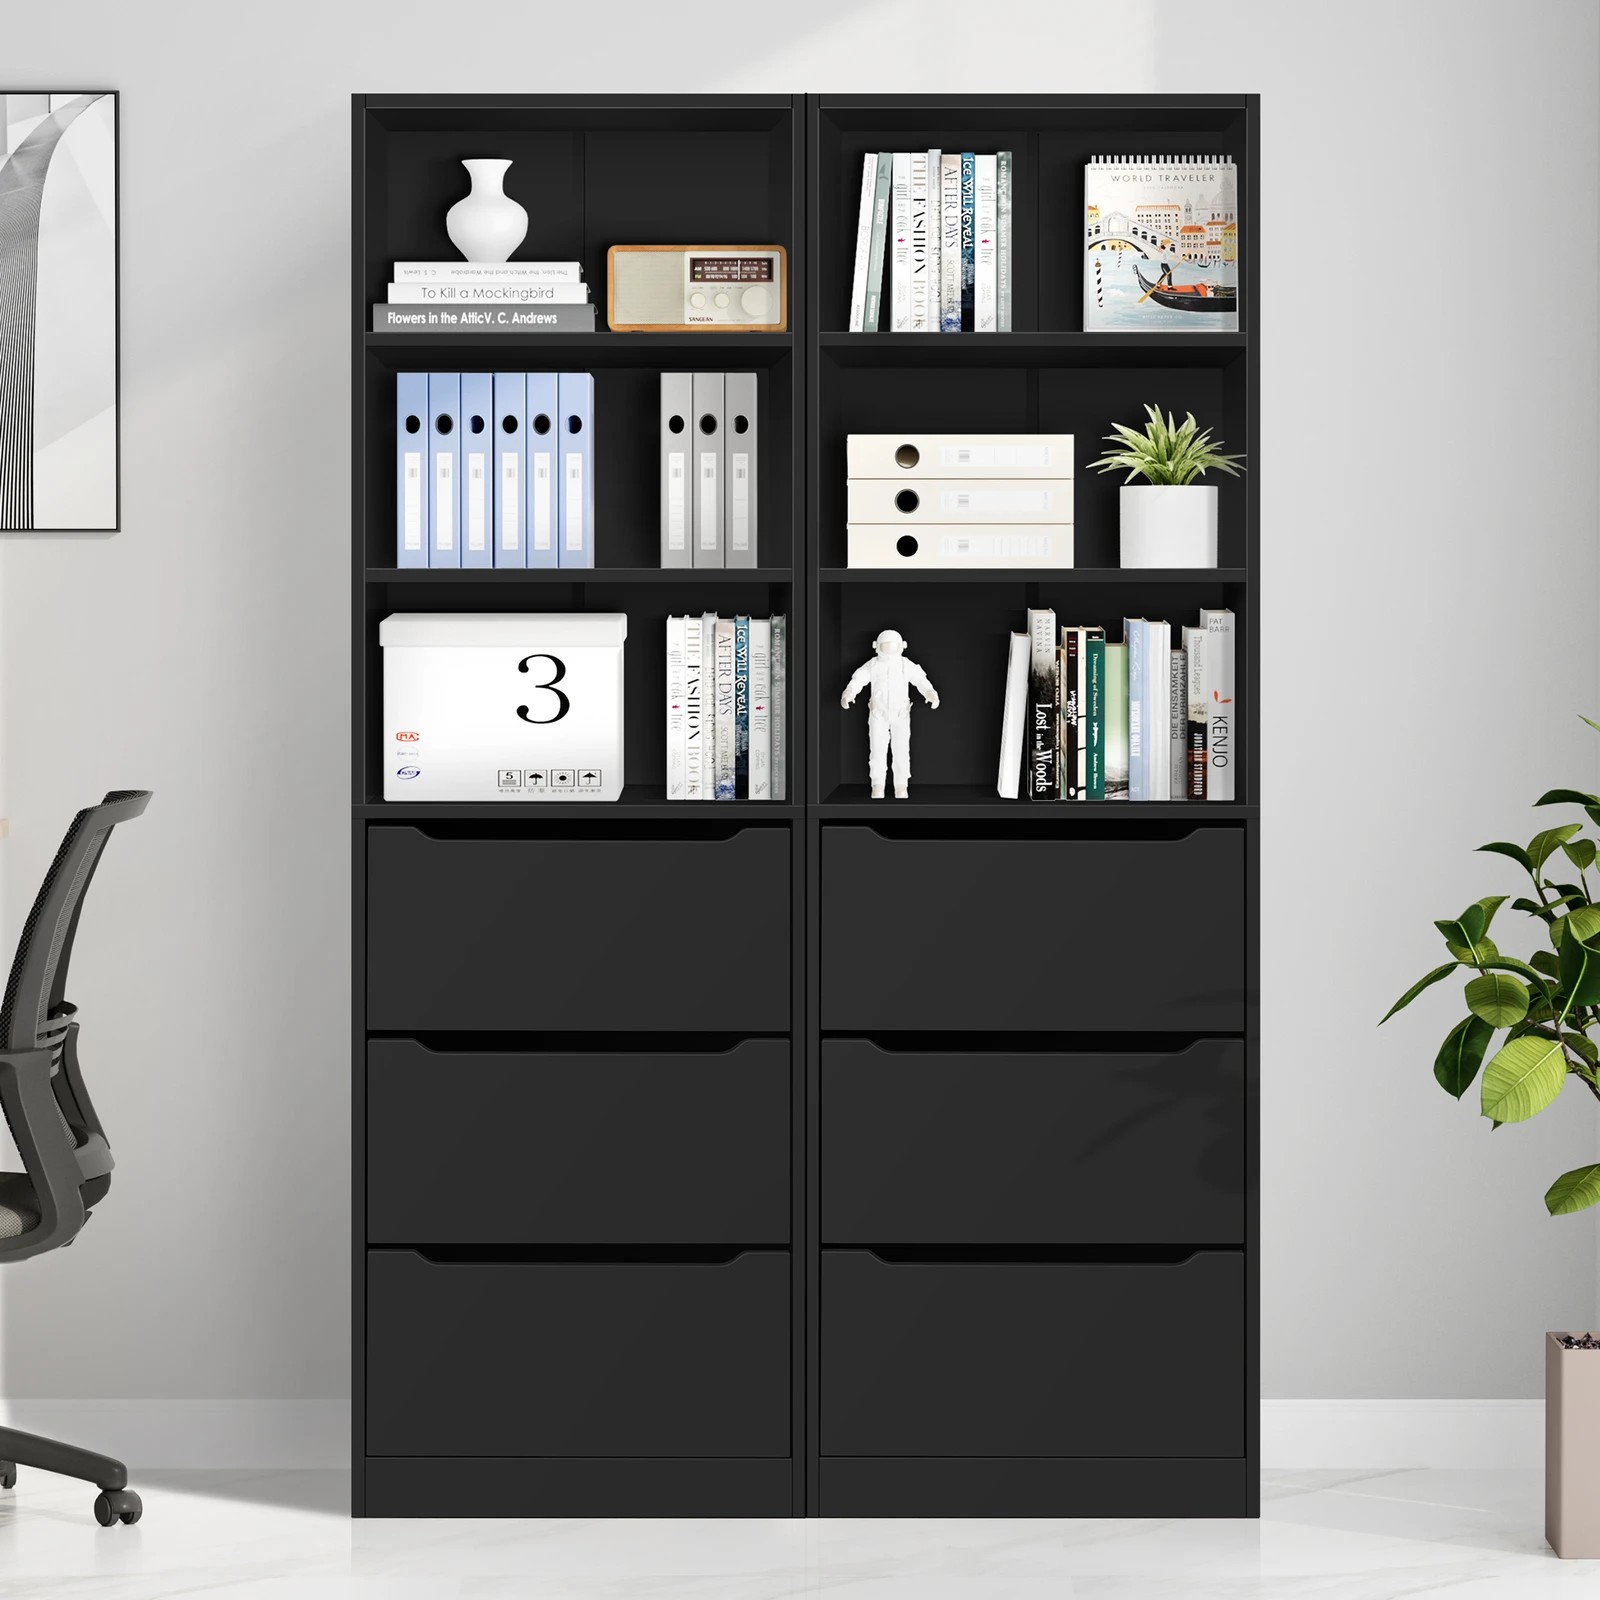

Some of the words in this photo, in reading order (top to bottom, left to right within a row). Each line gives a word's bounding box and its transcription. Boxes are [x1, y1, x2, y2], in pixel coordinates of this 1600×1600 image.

[913, 156, 926, 193] THE
[945, 167, 957, 210] AFTER
[1111, 174, 1152, 182] WORLD
[1159, 174, 1215, 182] TRAVELER
[913, 198, 926, 273] FASHION
[945, 216, 958, 248] DAYS
[422, 287, 437, 299] To
[441, 287, 457, 299] Kill
[460, 290, 469, 299] a
[472, 287, 554, 302] Mockingbird
[388, 311, 426, 325] Flowers
[430, 311, 438, 325] in
[441, 311, 458, 325] the
[498, 311, 509, 325] C.
[512, 311, 557, 325] Andrews
[688, 623, 700, 659] THE
[718, 635, 732, 678] AFTER
[1193, 636, 1202, 667] Thousand
[516, 654, 570, 724] 3
[1192, 669, 1202, 695] Leagues
[688, 665, 700, 740] FASHION
[718, 684, 732, 715] DAYS
[1036, 703, 1052, 730] Lost
[1036, 740, 1044, 750] the
[1212, 716, 1228, 768] KENJO
[1036, 750, 1052, 792] Woods
